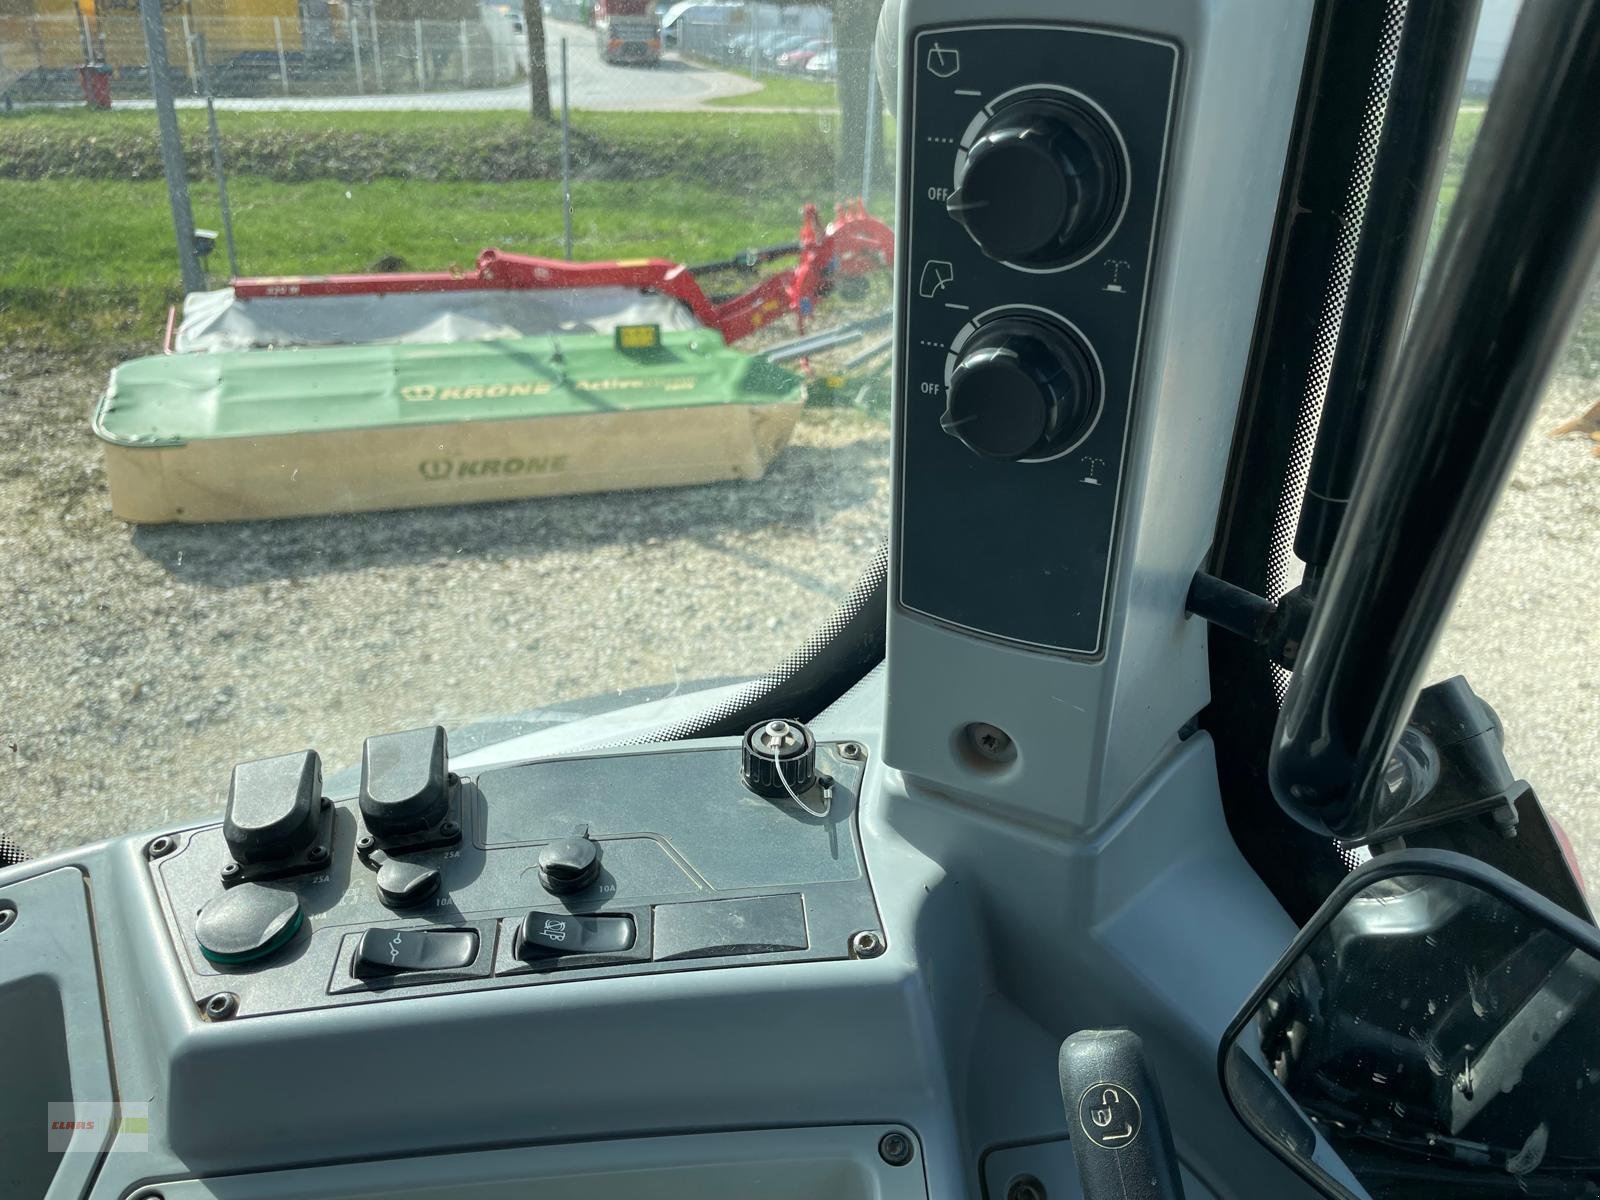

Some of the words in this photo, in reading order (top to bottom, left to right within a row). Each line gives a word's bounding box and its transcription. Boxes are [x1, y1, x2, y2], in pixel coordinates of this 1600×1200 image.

[928, 187, 949, 201] OFF
[439, 383, 551, 400] KRONE
[921, 382, 940, 395] OFF
[457, 455, 568, 477] KRONE
[600, 884, 616, 893] 10A
[436, 898, 453, 907] 10A
